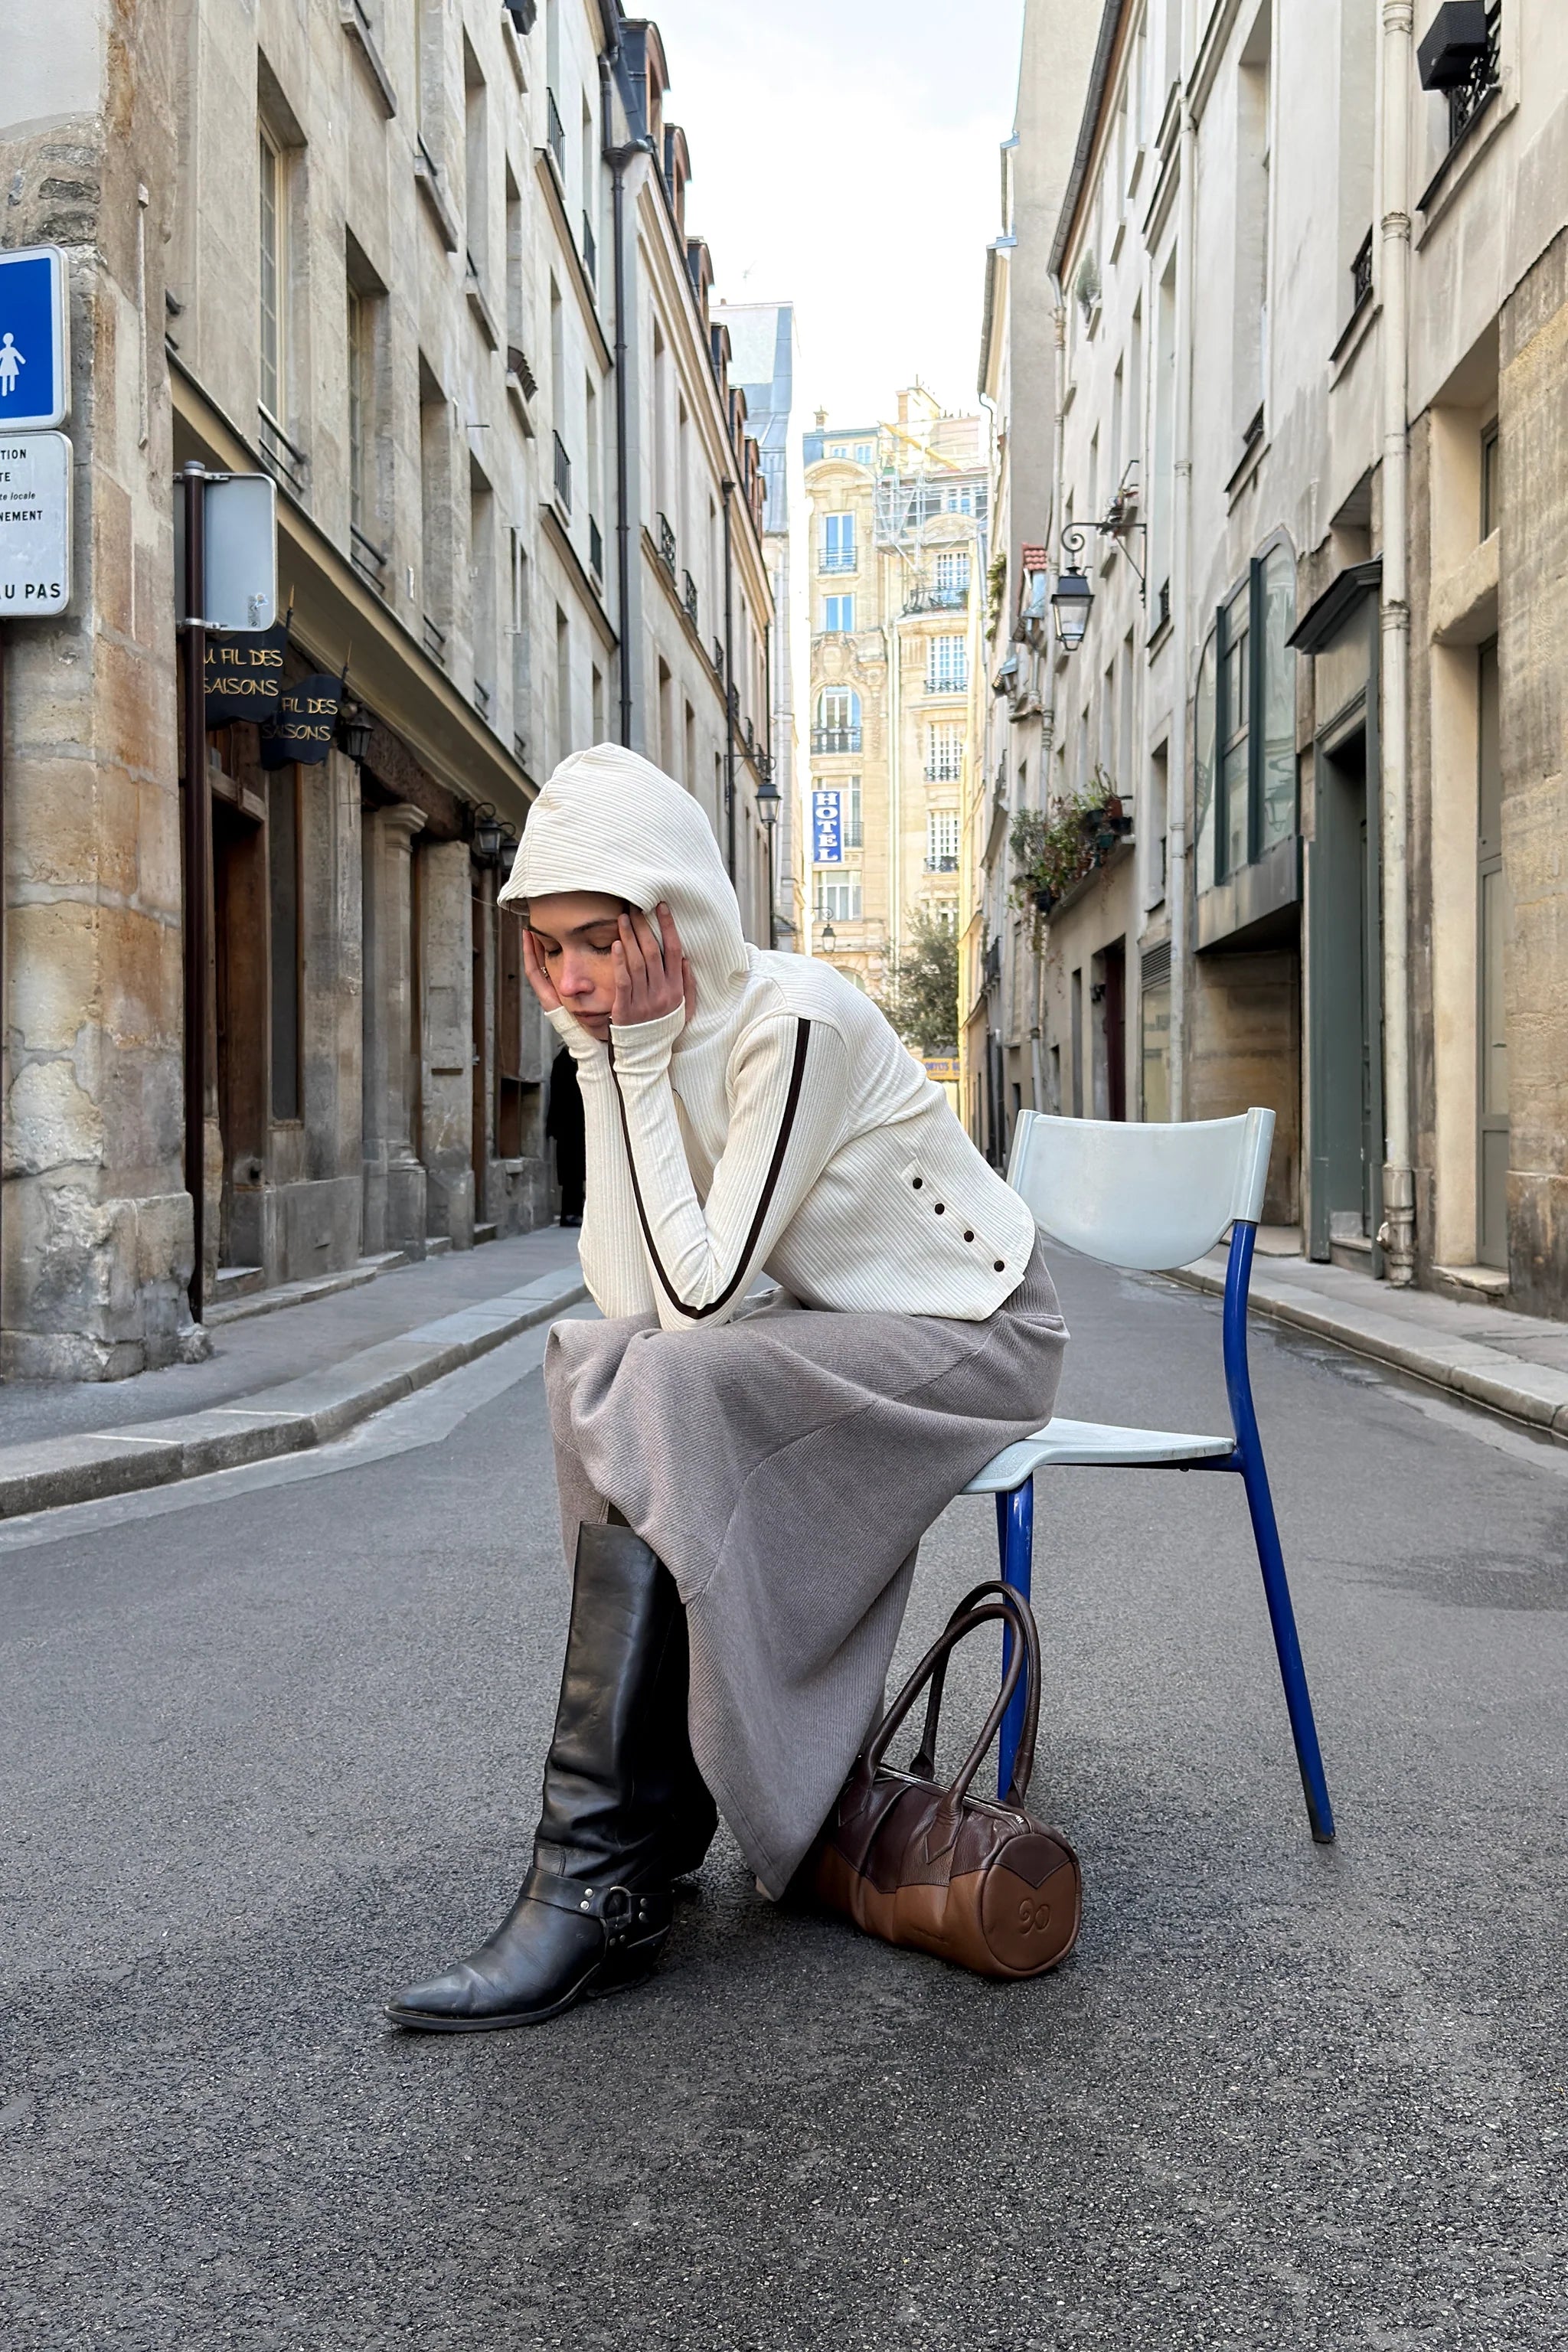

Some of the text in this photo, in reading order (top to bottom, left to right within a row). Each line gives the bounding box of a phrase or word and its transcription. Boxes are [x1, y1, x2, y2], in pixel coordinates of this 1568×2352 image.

[11, 491, 36, 500] locale
[0, 583, 60, 599] U PAS
[204, 648, 283, 667] U FIL DES
[204, 677, 279, 697] SAISONS
[282, 697, 338, 715] FIL DES
[815, 792, 839, 861] HOTEL
